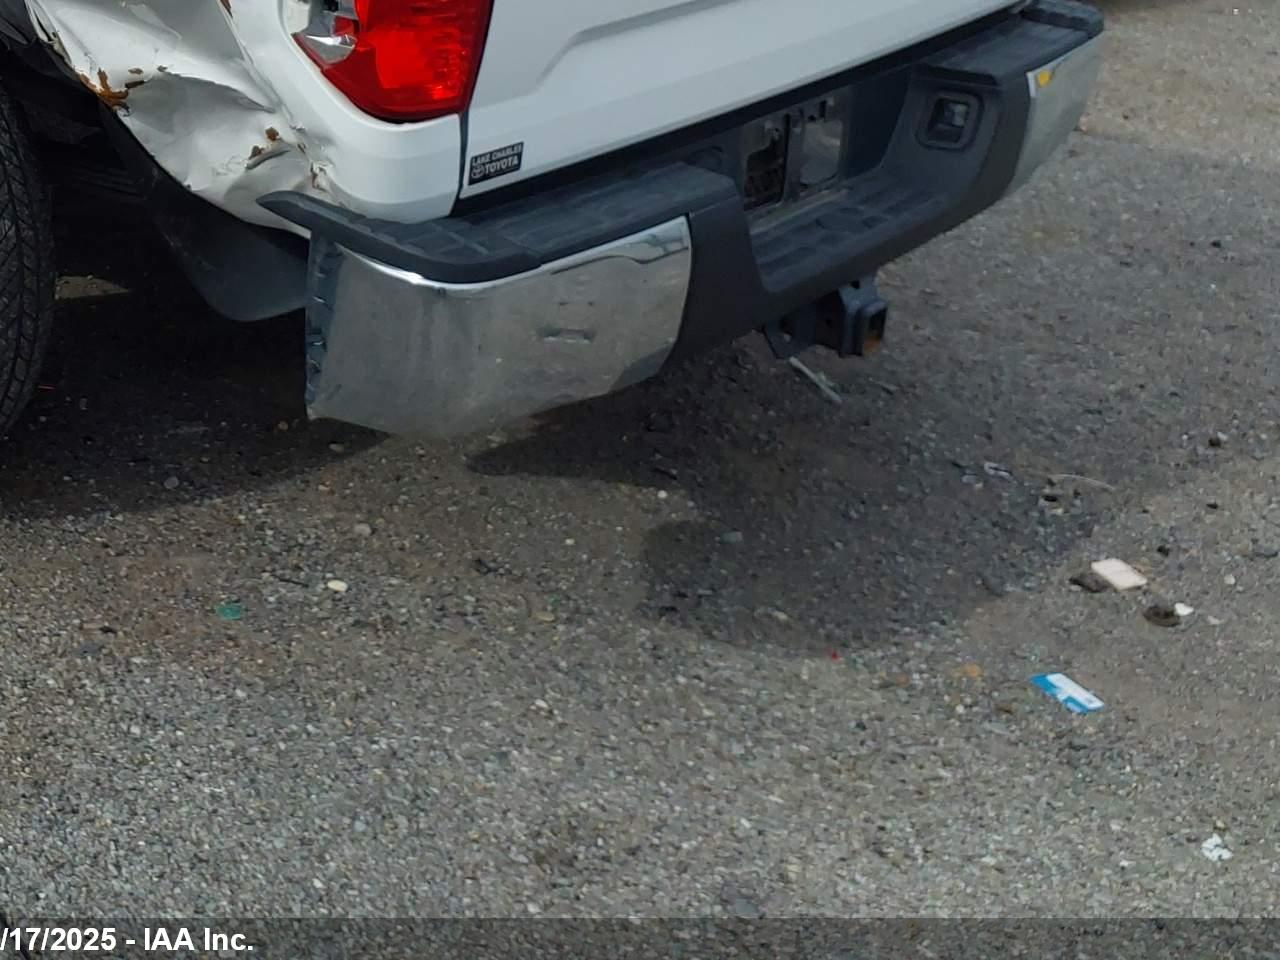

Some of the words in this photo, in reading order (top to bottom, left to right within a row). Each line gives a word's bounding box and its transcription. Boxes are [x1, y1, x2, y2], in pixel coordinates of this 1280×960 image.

[472, 152, 491, 167] LAKE
[491, 143, 523, 161] CHARLES
[485, 155, 519, 175] TOYOTA
